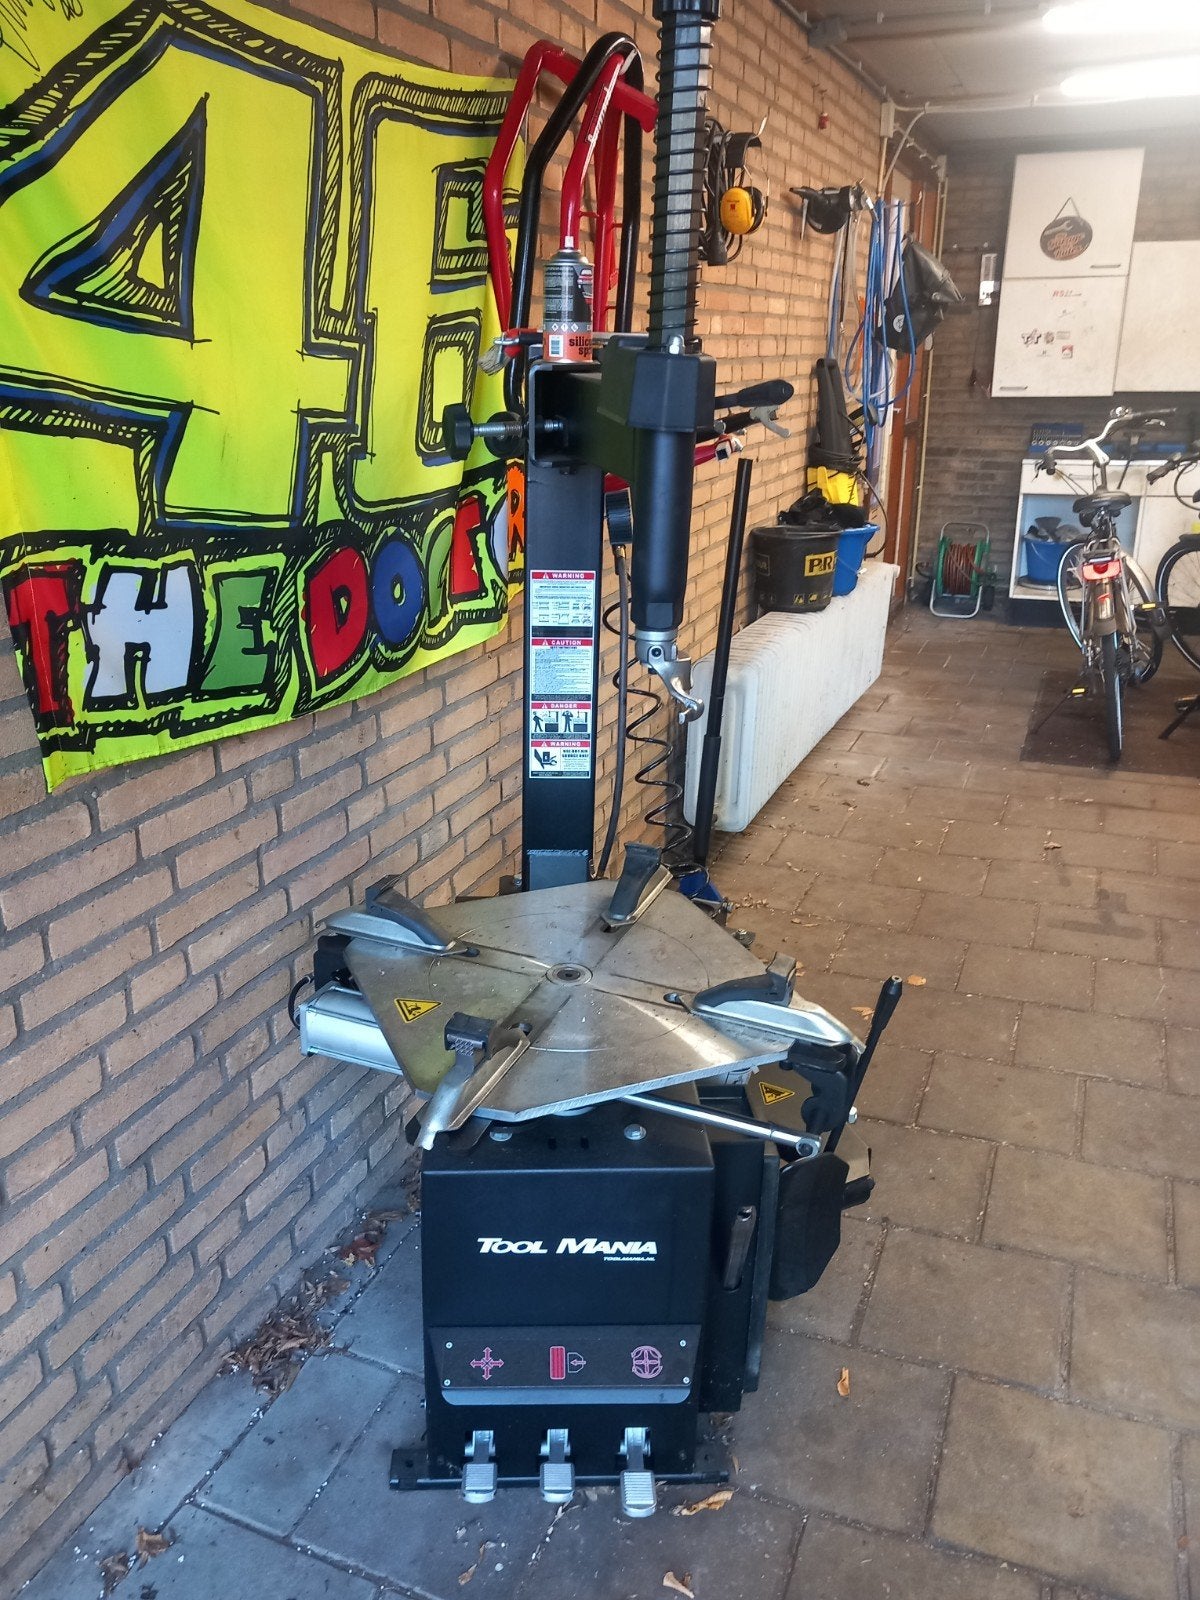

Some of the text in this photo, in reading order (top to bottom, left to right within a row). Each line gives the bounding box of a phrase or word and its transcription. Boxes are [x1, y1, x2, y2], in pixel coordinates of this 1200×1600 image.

[809, 555, 833, 573] P&R
[4, 560, 277, 722] THE
[477, 1237, 658, 1254] TOOL MANIA
